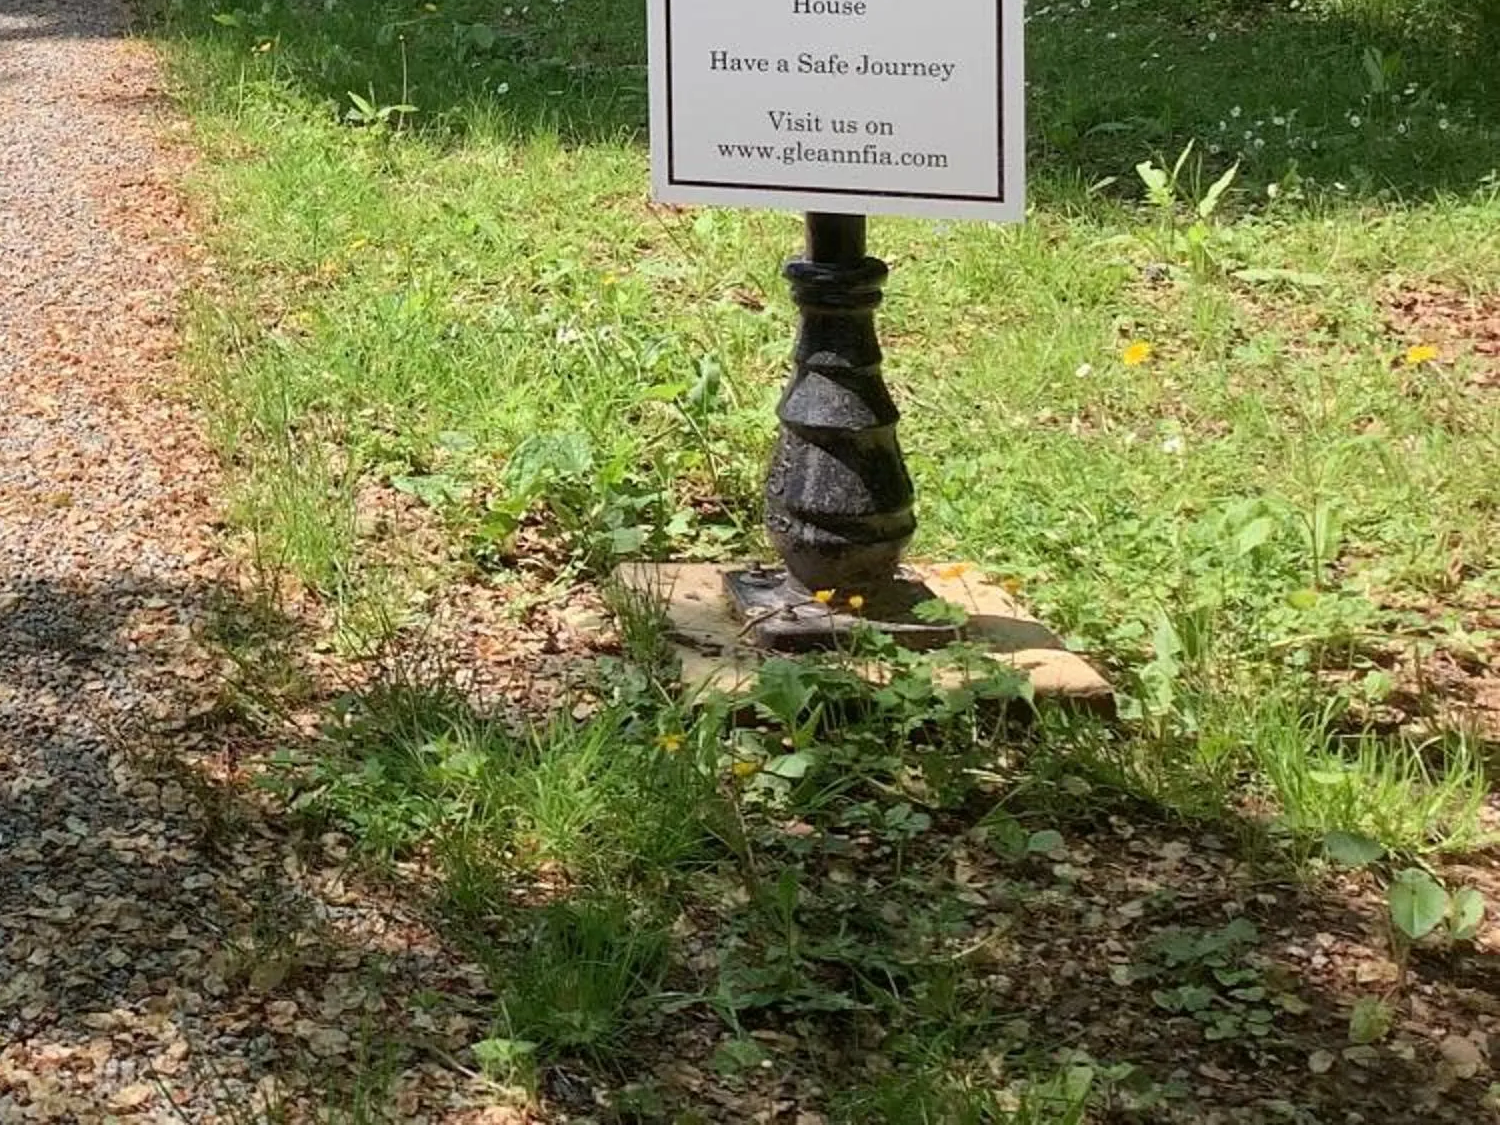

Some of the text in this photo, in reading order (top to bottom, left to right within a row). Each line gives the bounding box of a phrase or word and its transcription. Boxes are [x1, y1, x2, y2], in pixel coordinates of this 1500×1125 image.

[710, 51, 955, 81] Have a Safe Journey
[768, 111, 894, 136] Visit us on
[717, 141, 948, 168] www.gleannfia.com
